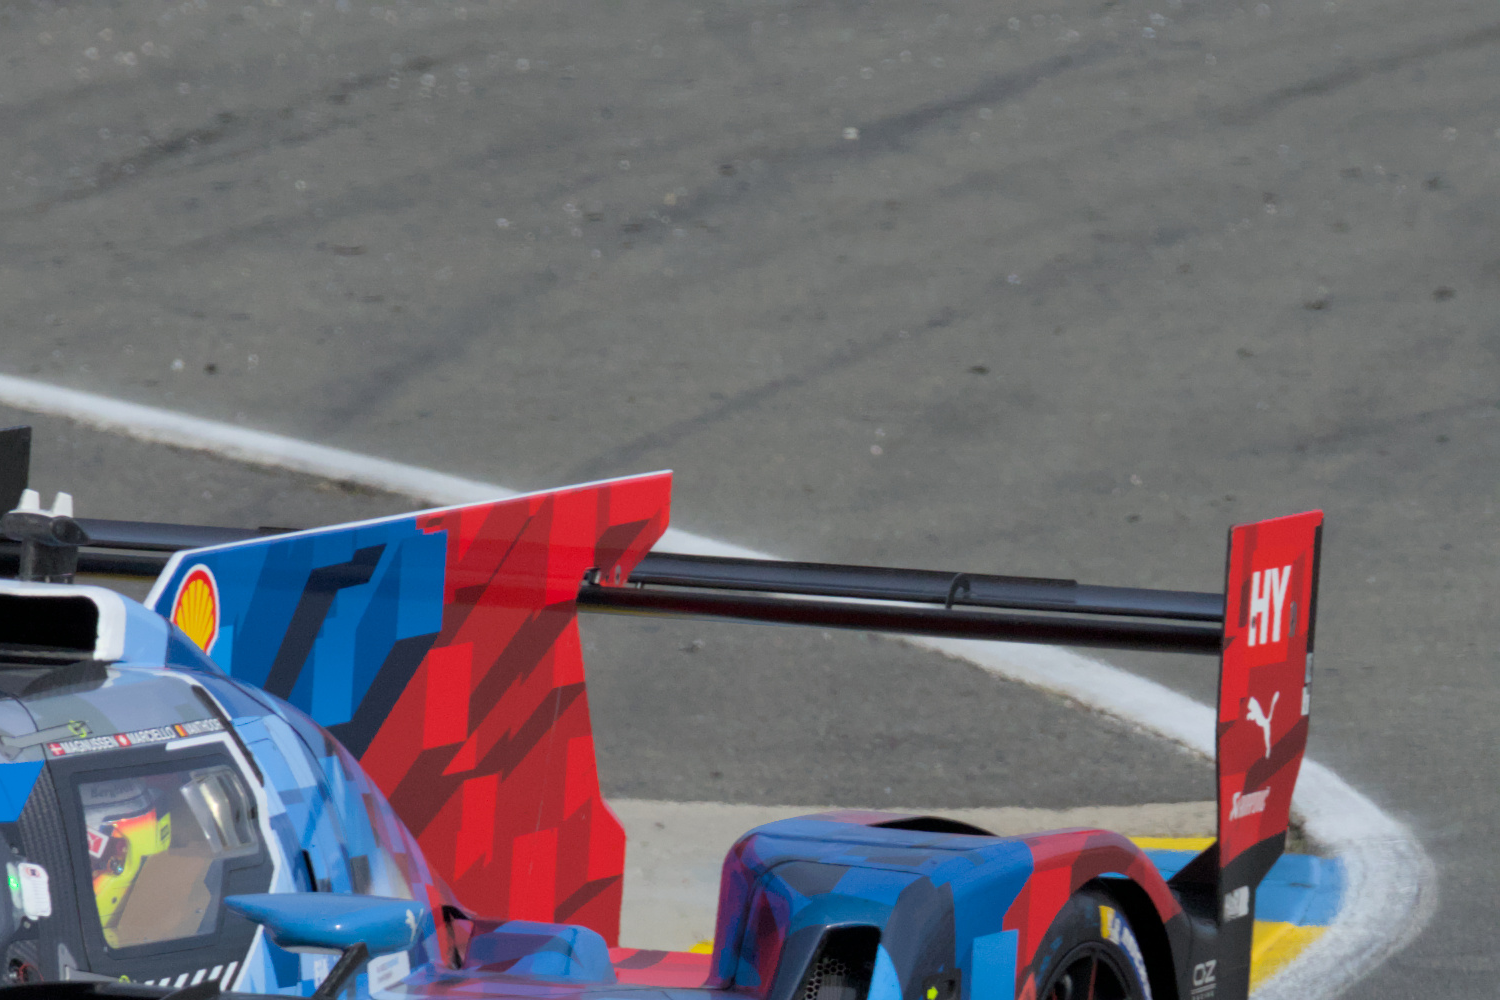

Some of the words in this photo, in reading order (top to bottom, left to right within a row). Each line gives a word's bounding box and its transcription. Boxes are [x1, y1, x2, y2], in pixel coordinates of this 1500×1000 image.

[1247, 565, 1292, 647] HY
[63, 735, 117, 754] MAGNUSSEN
[126, 726, 177, 745] MARCIELLO
[1192, 959, 1218, 987] OZ
